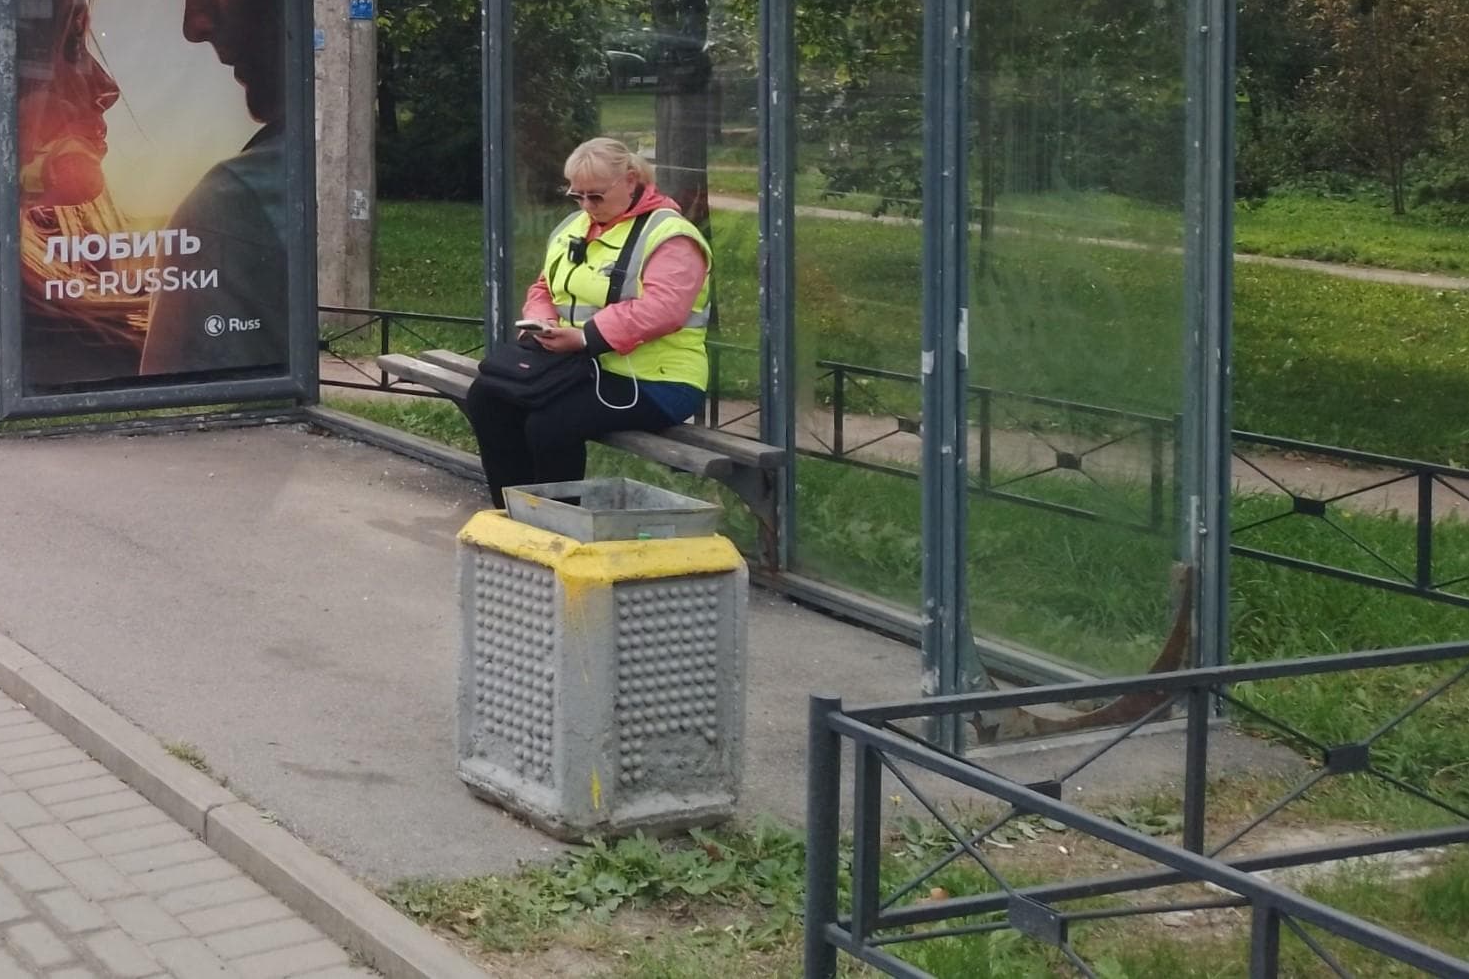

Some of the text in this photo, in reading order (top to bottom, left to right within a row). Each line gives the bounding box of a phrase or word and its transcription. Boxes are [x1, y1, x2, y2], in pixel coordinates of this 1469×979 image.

[43, 228, 202, 264] ЛЮБИТЬ
[44, 266, 219, 300] по-RUSSки
[228, 317, 262, 332] Russ
